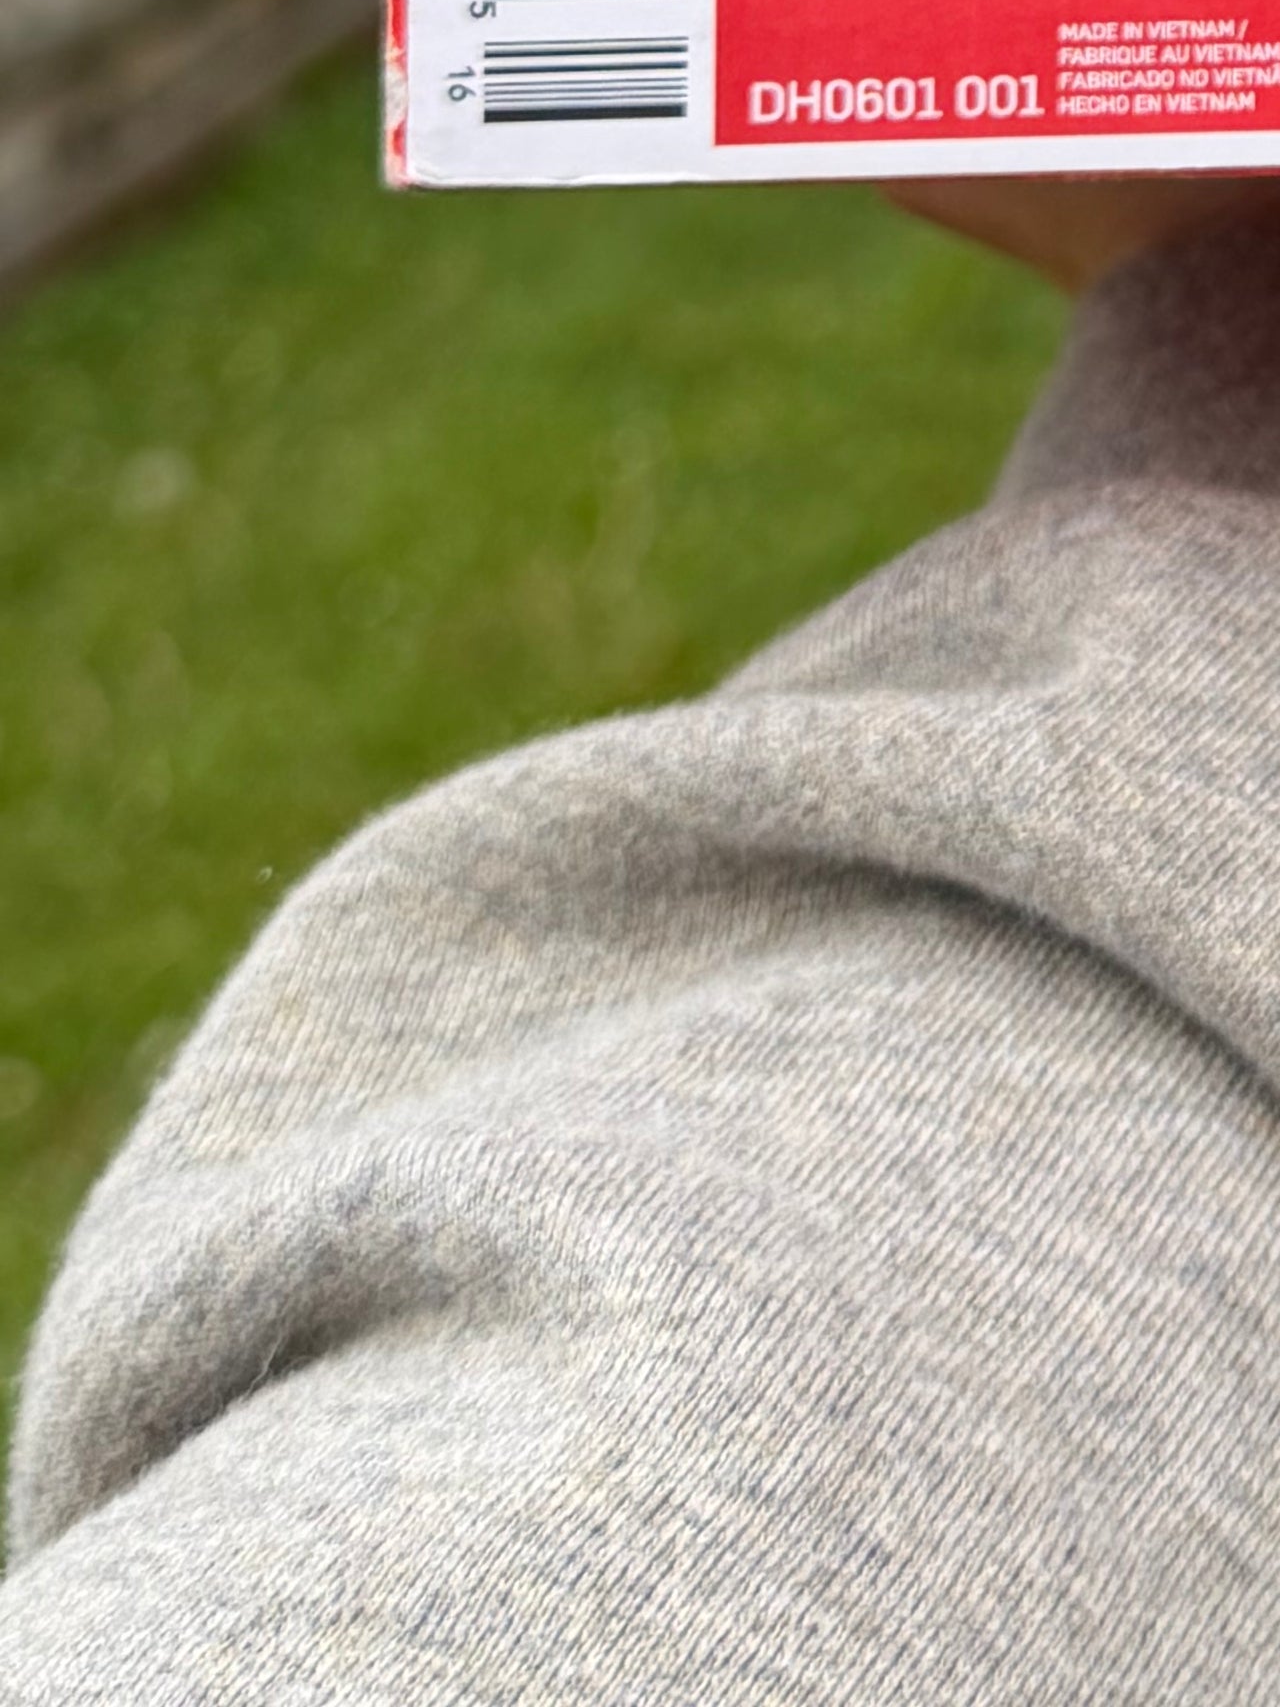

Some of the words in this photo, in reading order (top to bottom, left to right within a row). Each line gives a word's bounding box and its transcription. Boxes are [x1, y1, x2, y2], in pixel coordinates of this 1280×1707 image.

[468, 1, 497, 20] 5
[1057, 22, 1119, 42] MADE
[1122, 21, 1143, 40] IN
[1057, 45, 1157, 66] FABRIQUE
[1160, 44, 1190, 64] AU
[447, 66, 476, 103] 16
[1057, 69, 1175, 91] FABRICADO
[1178, 68, 1209, 89] NO
[749, 76, 944, 125] DH0601
[954, 74, 1045, 120] 001
[1057, 94, 1130, 115] HECHO
[1132, 93, 1162, 114] EN
[1164, 91, 1256, 112] VIETNAM
